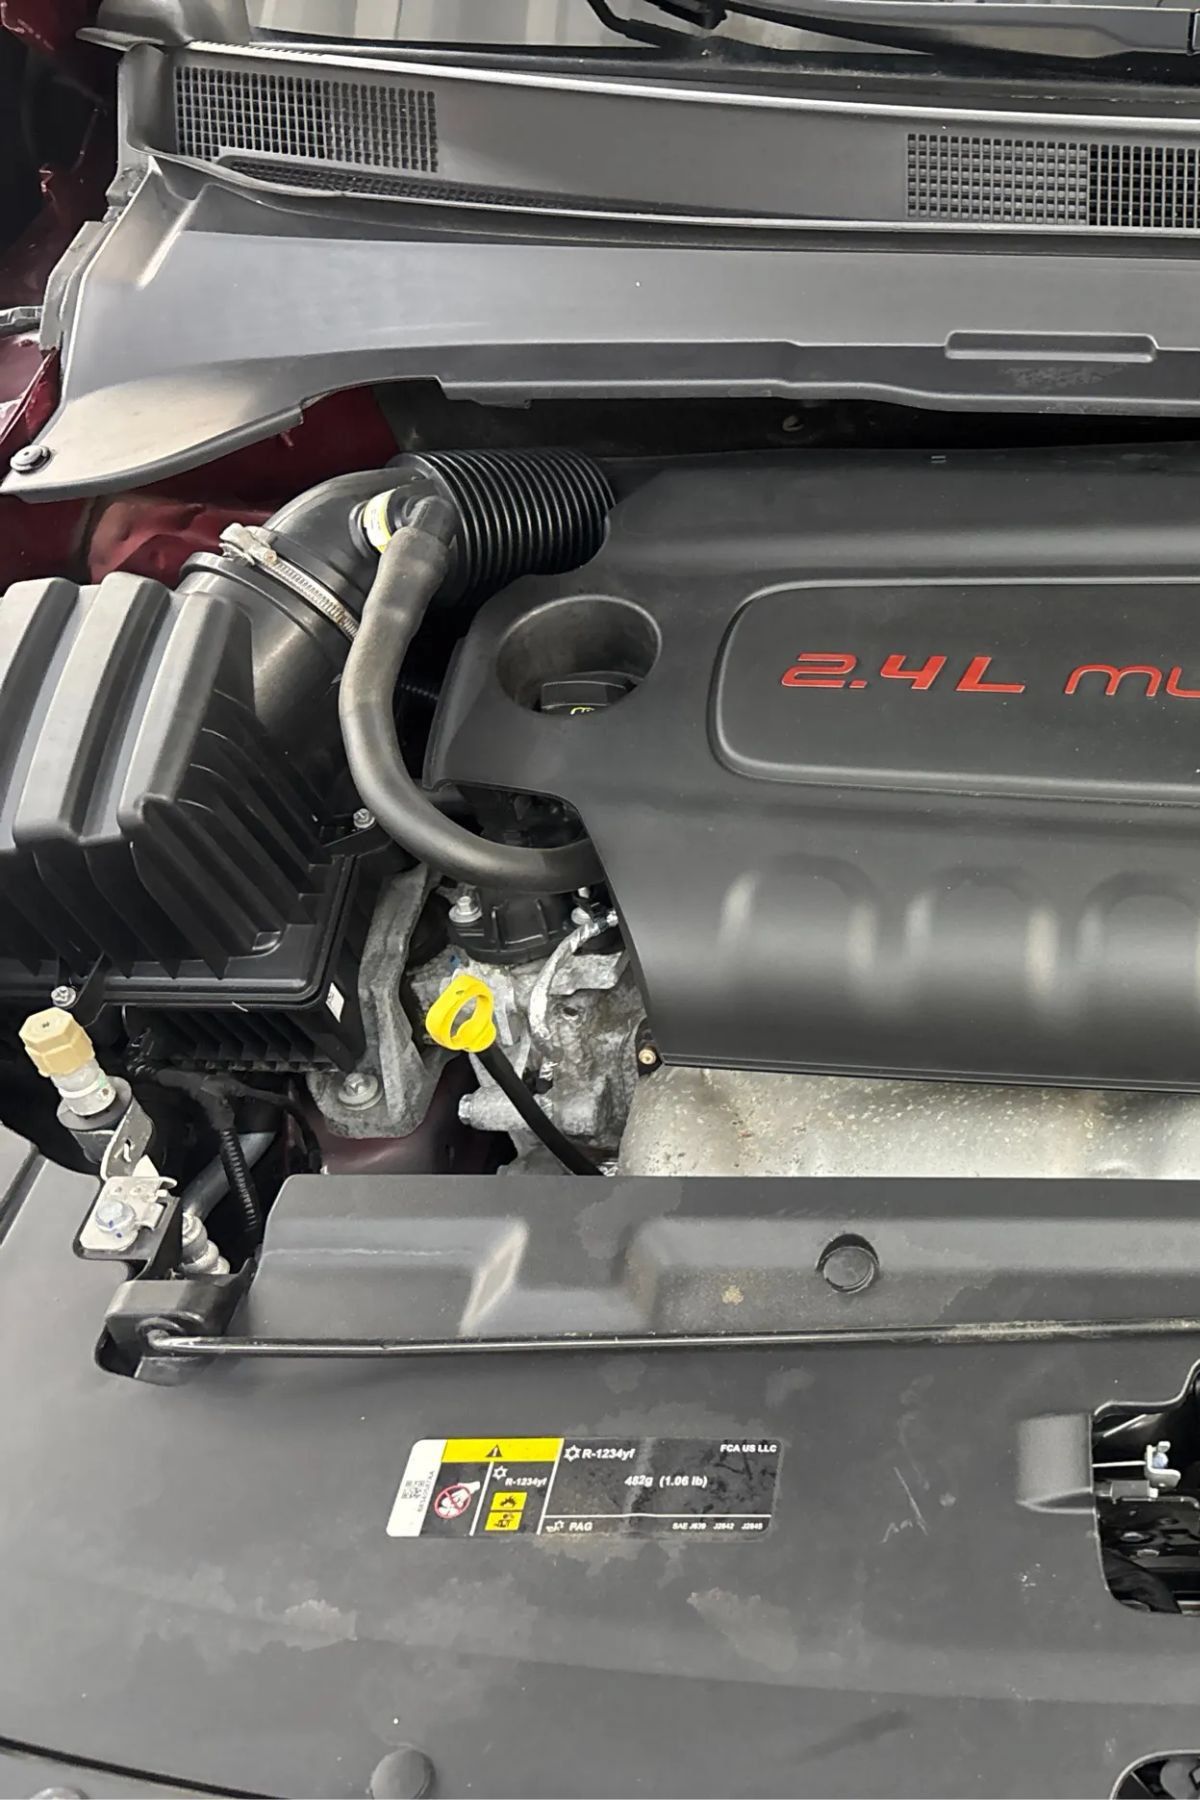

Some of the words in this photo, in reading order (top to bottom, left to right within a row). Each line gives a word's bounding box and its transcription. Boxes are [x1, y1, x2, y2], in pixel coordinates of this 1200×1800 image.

[781, 652, 1026, 695] 2.4L
[720, 1444, 740, 1453] FCA
[742, 1444, 756, 1453] US
[758, 1444, 777, 1453] LLC
[581, 1448, 636, 1461] R-1234yf
[504, 1477, 548, 1487] R-1234yf
[659, 1475, 689, 1488] (1.06
[691, 1475, 708, 1488] lb)
[569, 1521, 593, 1532] PAG
[672, 1522, 689, 1530] SAE
